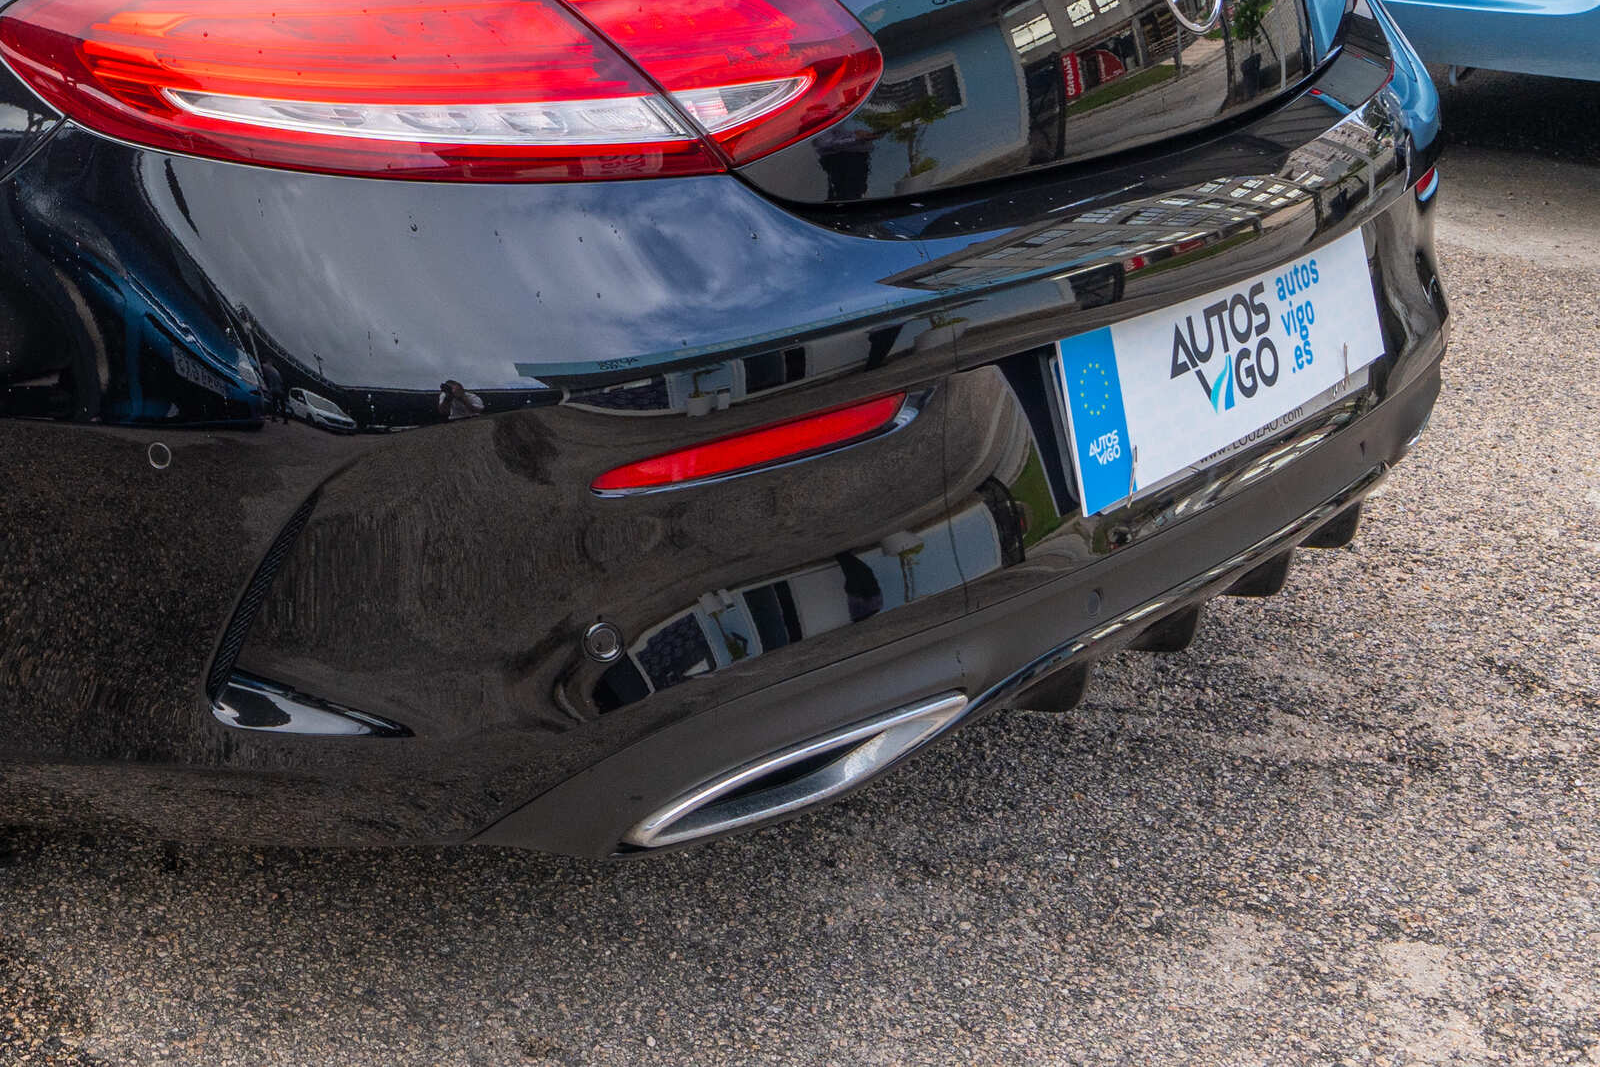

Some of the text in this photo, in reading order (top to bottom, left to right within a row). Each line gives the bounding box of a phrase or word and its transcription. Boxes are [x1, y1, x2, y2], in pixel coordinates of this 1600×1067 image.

[1275, 259, 1319, 301] autos
[1170, 281, 1271, 380] AUTOS
[1281, 300, 1315, 341] vigo
[1194, 336, 1280, 413] VIGO
[1292, 340, 1314, 374] .es
[1089, 429, 1118, 457] AUTOS
[1095, 444, 1121, 465] VIGO
